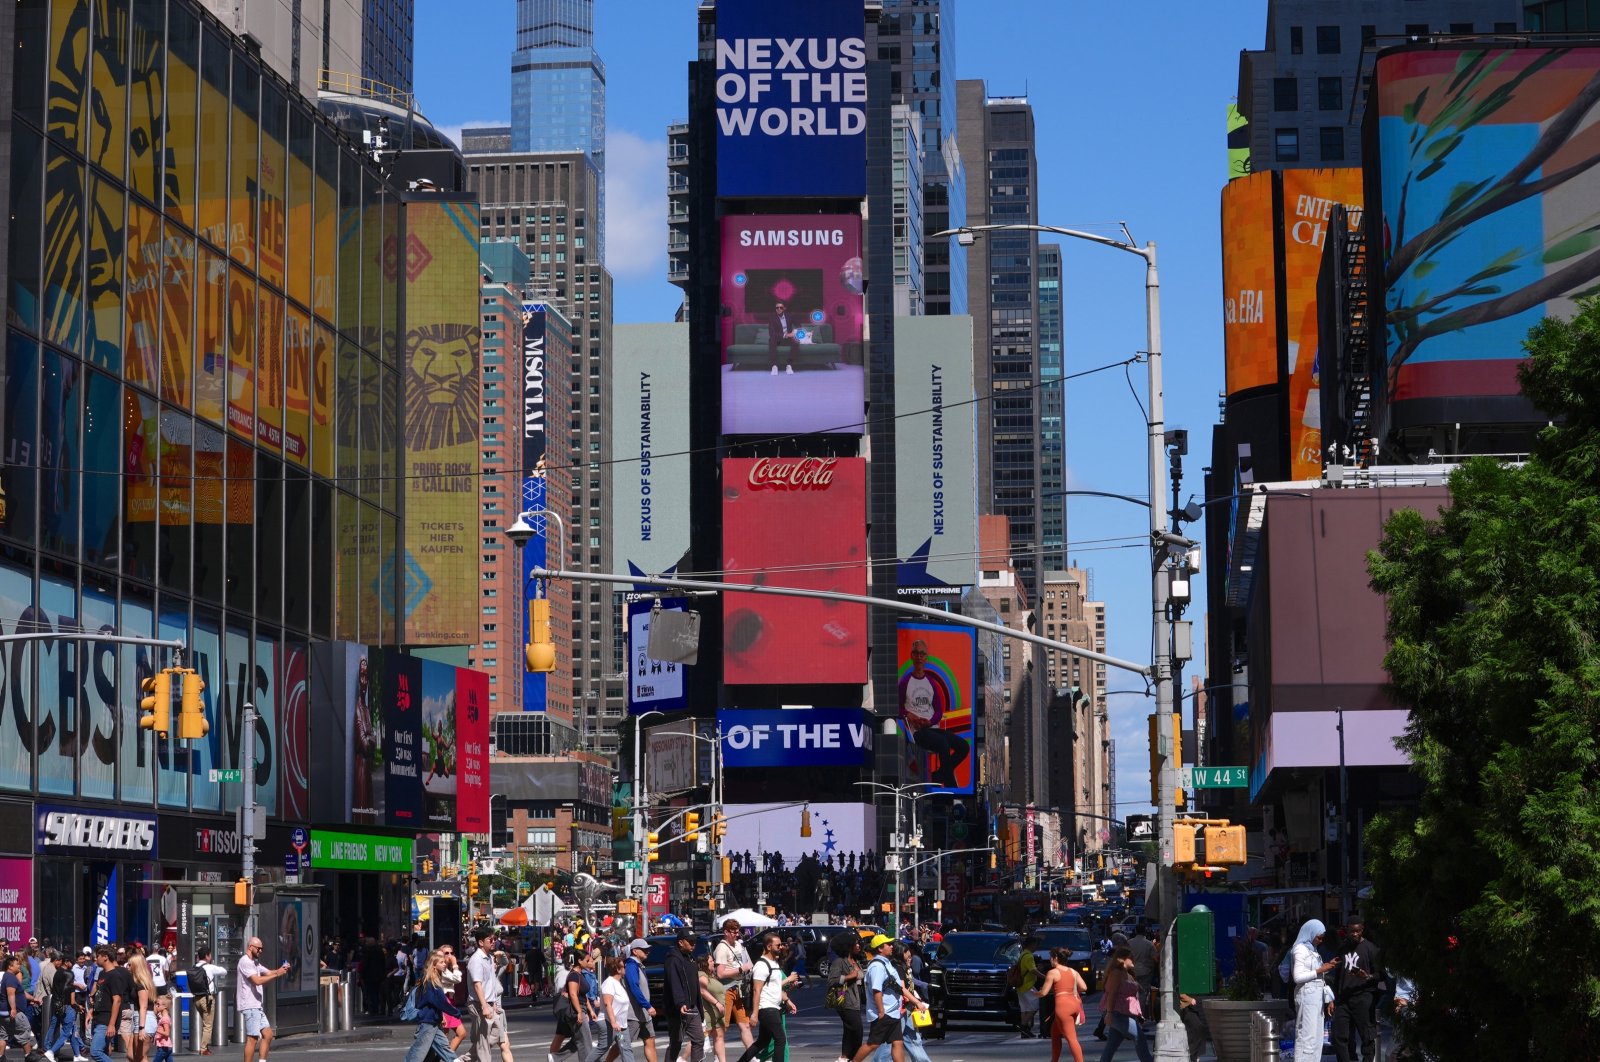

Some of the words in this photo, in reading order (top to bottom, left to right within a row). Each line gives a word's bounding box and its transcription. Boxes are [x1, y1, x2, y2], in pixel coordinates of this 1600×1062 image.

[716, 38, 865, 70] NEXUS
[716, 72, 772, 103] OF
[782, 73, 866, 103] THE
[717, 107, 866, 136] WORLD
[247, 176, 284, 258] THE
[1296, 194, 1341, 222] ENTE
[740, 229, 844, 246] SAMSUNG
[1240, 289, 1263, 324] ERA
[641, 371, 651, 476] SUSTAINABILITY
[931, 364, 943, 469] SUSTAINABILITY
[229, 405, 253, 430] ENTRANCE
[258, 422, 267, 435] ON
[268, 426, 280, 444] 45TH
[285, 432, 300, 455] STREET
[412, 462, 442, 476] PRIDE
[444, 462, 472, 475] ROCK
[933, 472, 943, 489] OF
[412, 482, 420, 492] IS
[422, 477, 472, 493] CALLING
[641, 479, 651, 495] OF
[420, 522, 464, 531] TICKETS
[641, 498, 651, 541] NEXUS
[934, 492, 944, 535] NEXUS
[420, 545, 464, 554] KAUFEN
[430, 534, 454, 542] HIER
[415, 631, 470, 641] lionking.com
[11, 605, 125, 767] CBS
[727, 724, 770, 749] OF
[776, 723, 841, 749] THE
[217, 772, 223, 781] W
[225, 772, 234, 781] 44
[1195, 770, 1207, 786] W
[1213, 769, 1231, 785] 44
[1236, 769, 1246, 779] St
[43, 811, 156, 851] SKECHERS
[330, 841, 344, 860] LINE
[344, 841, 368, 861] FRIENDS
[374, 844, 388, 862] NEW
[388, 845, 403, 863] YORK
[652, 876, 667, 904] tkts
[13, 907, 27, 923] SPACE
[7, 926, 21, 942] LEASE
